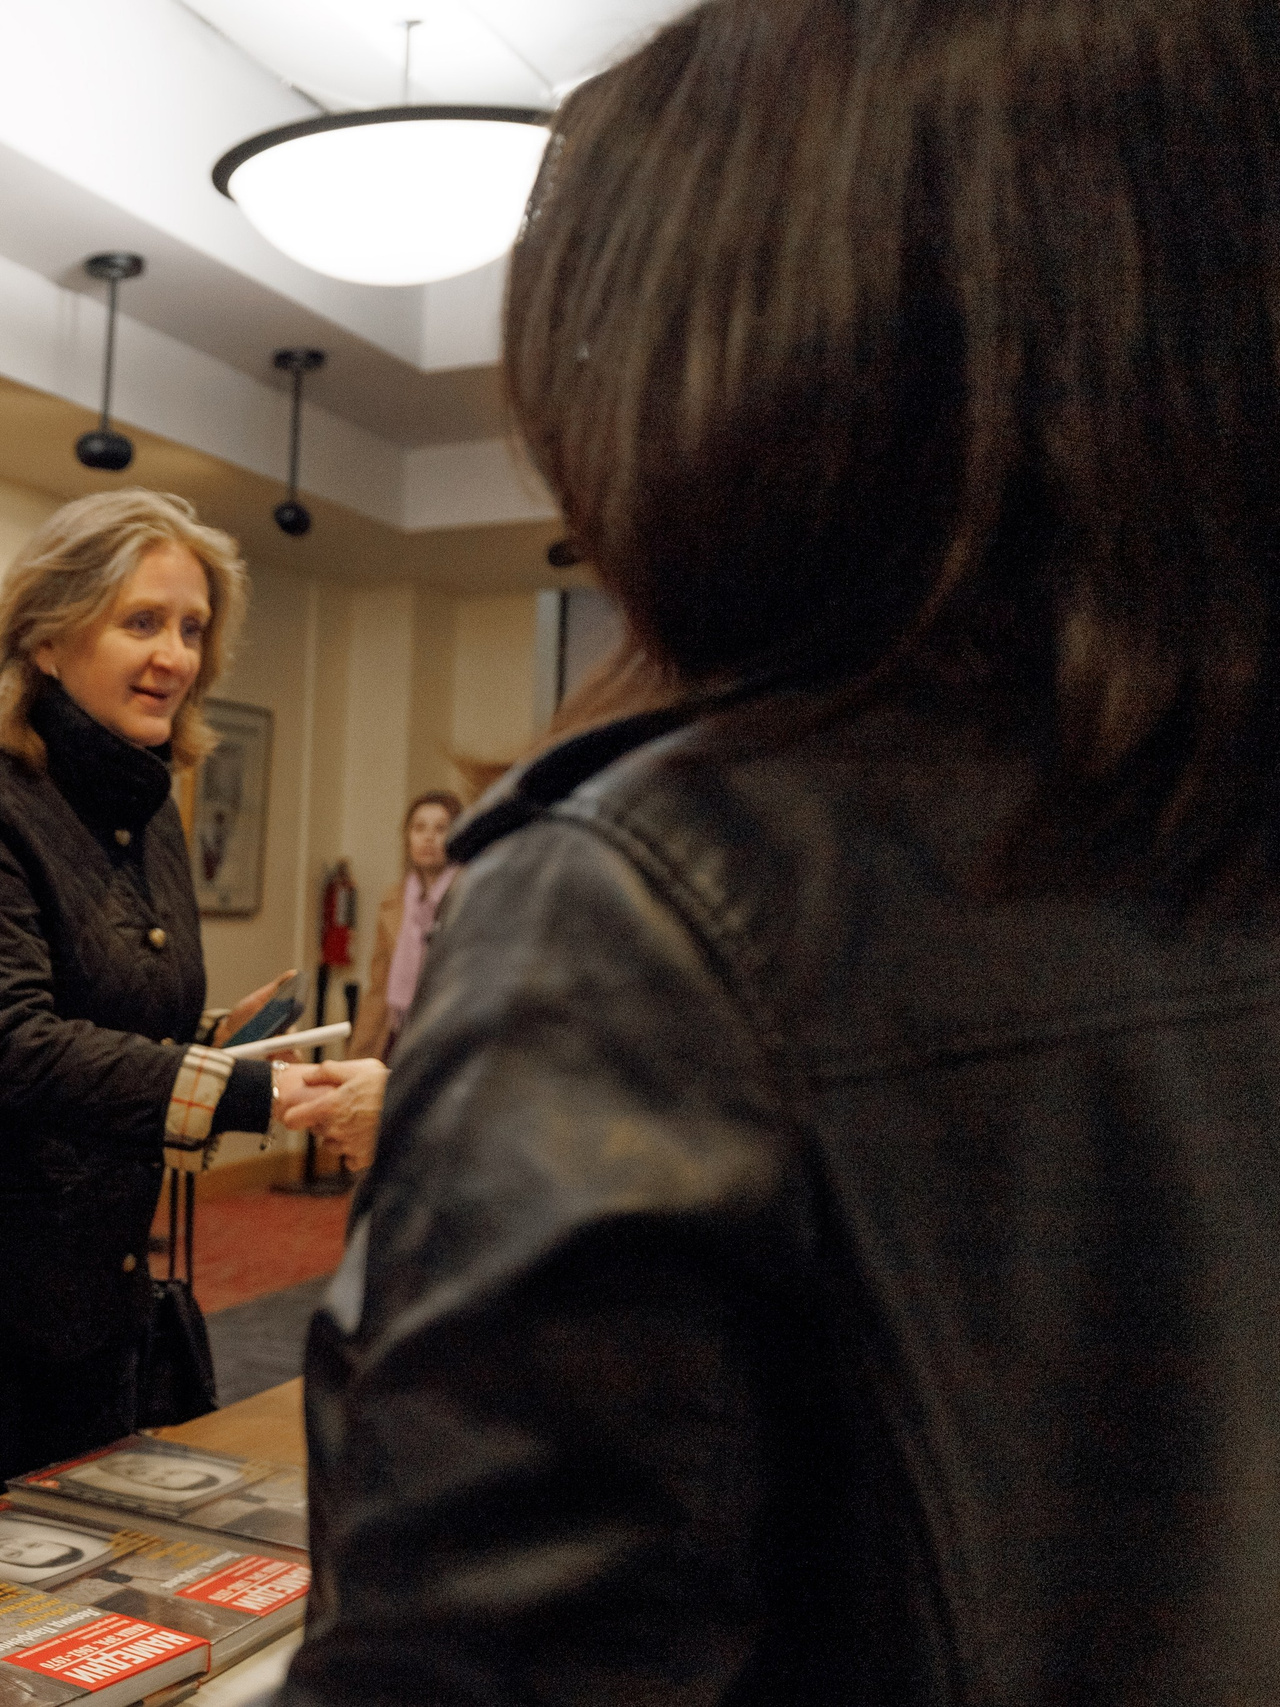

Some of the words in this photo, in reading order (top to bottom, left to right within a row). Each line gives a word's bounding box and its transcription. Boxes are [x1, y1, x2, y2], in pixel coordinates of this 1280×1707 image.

[46, 1607, 102, 1633] Леонид
[92, 1633, 123, 1648] ЭРА.
[121, 1623, 149, 1638] НАША
[63, 1631, 192, 1684] НАМЕДНИ
